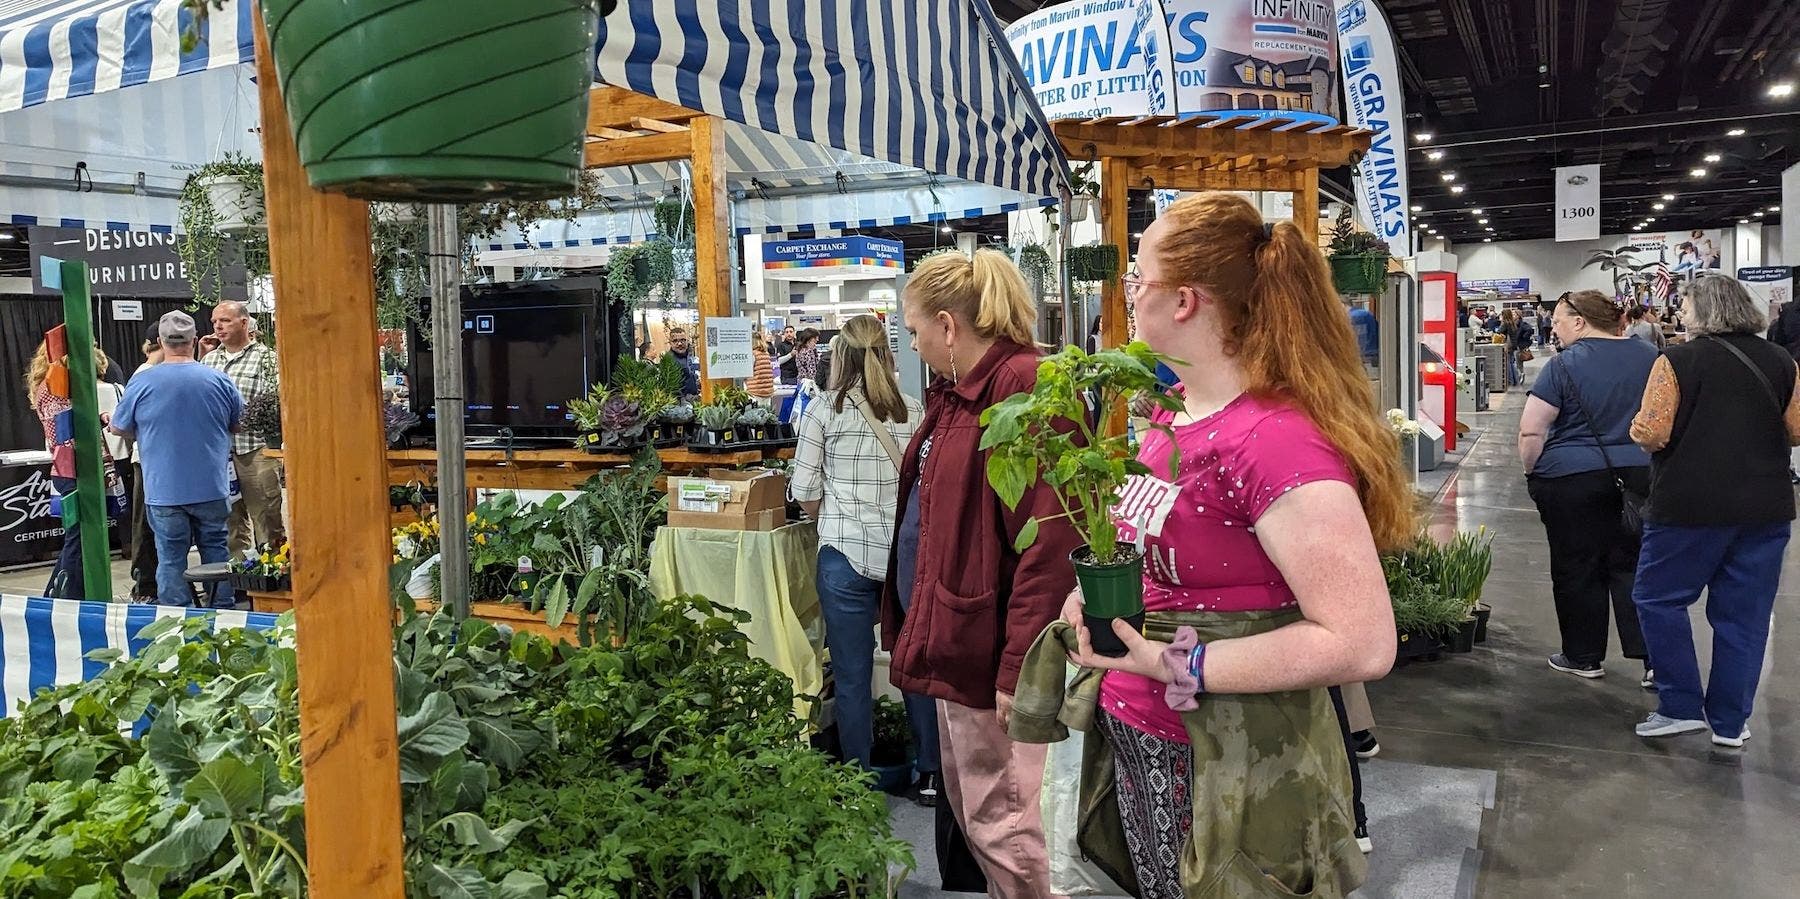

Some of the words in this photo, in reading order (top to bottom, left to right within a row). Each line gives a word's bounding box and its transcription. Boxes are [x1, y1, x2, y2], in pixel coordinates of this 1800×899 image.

[1031, 16, 1048, 31] from
[1049, 7, 1081, 25] Marvin
[1083, 0, 1125, 16] Window
[1253, 0, 1331, 26] INFINITY
[1306, 26, 1329, 41] MARVIN
[1020, 11, 1209, 88] AVINA'S
[1254, 41, 1307, 53] REPLACEMENT
[1036, 86, 1067, 107] TER
[1071, 81, 1092, 100] OF
[1349, 82, 1365, 125] WINDOW
[1360, 73, 1405, 237] GRAVINA'S
[1365, 169, 1375, 182] OF
[1561, 206, 1595, 219] 1300
[85, 229, 176, 252] DESIGNS
[776, 244, 804, 254] CARPET
[806, 242, 848, 252] EXCHANGE
[89, 262, 188, 284] URNITURE
[14, 527, 66, 543] CERTIFIED
